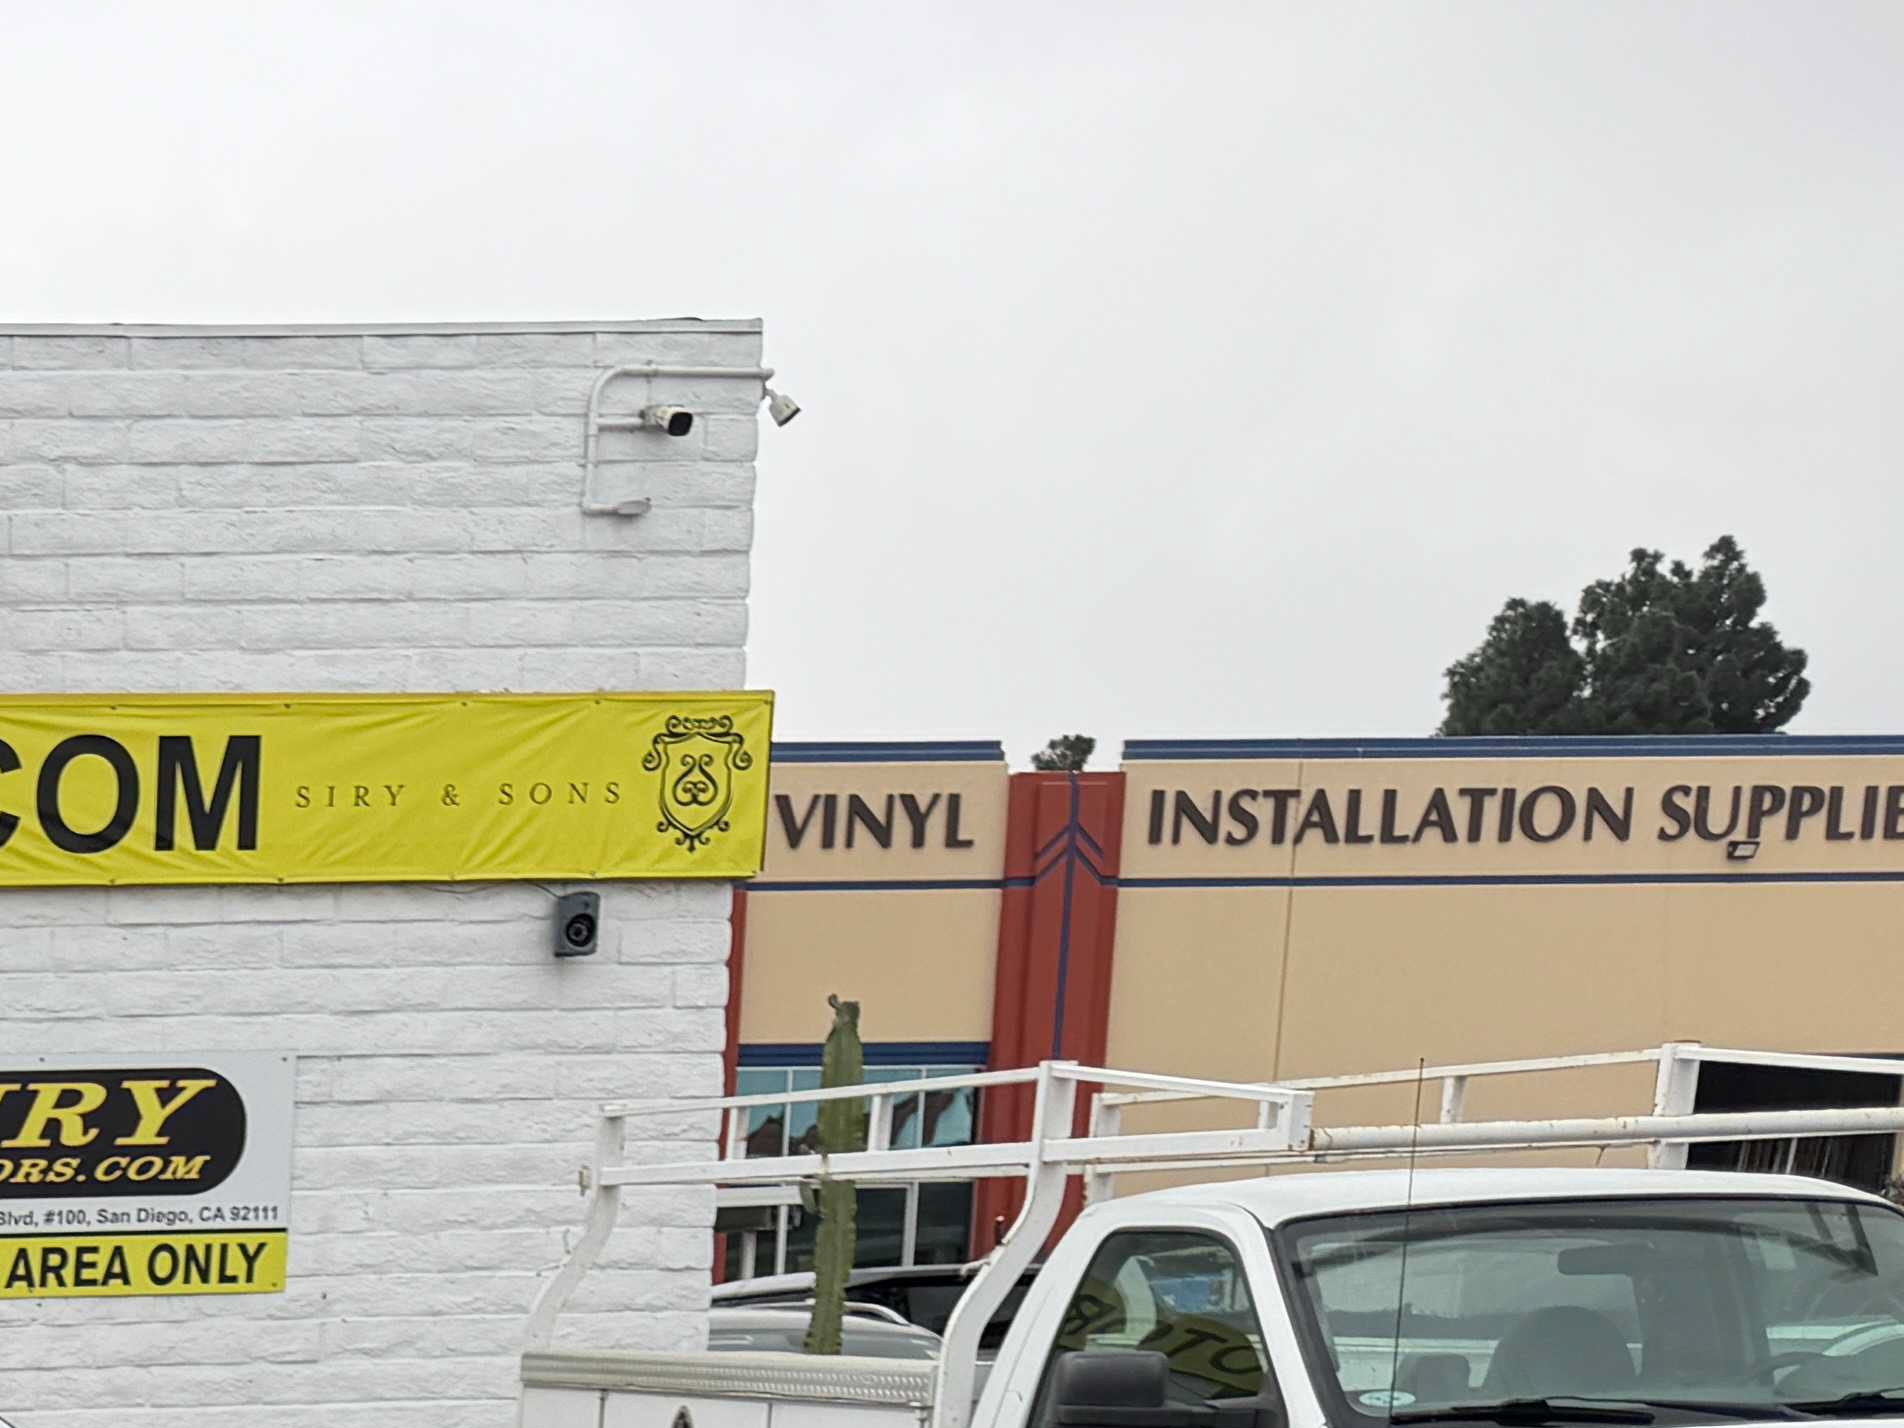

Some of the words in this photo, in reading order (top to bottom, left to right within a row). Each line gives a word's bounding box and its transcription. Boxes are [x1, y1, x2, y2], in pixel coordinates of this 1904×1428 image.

[294, 784, 406, 809] SIRY
[440, 784, 460, 807] &
[498, 782, 622, 805] SONS
[1147, 784, 1635, 847] INSTALLATION
[774, 793, 975, 850] VINYL
[43, 1208, 93, 1227] #100,
[95, 1208, 132, 1226] San
[135, 1206, 194, 1226] Diego,
[198, 1206, 227, 1222] CA
[229, 1205, 279, 1222] 92111
[4, 1244, 132, 1290] AREA
[147, 1241, 270, 1286] ONLY
